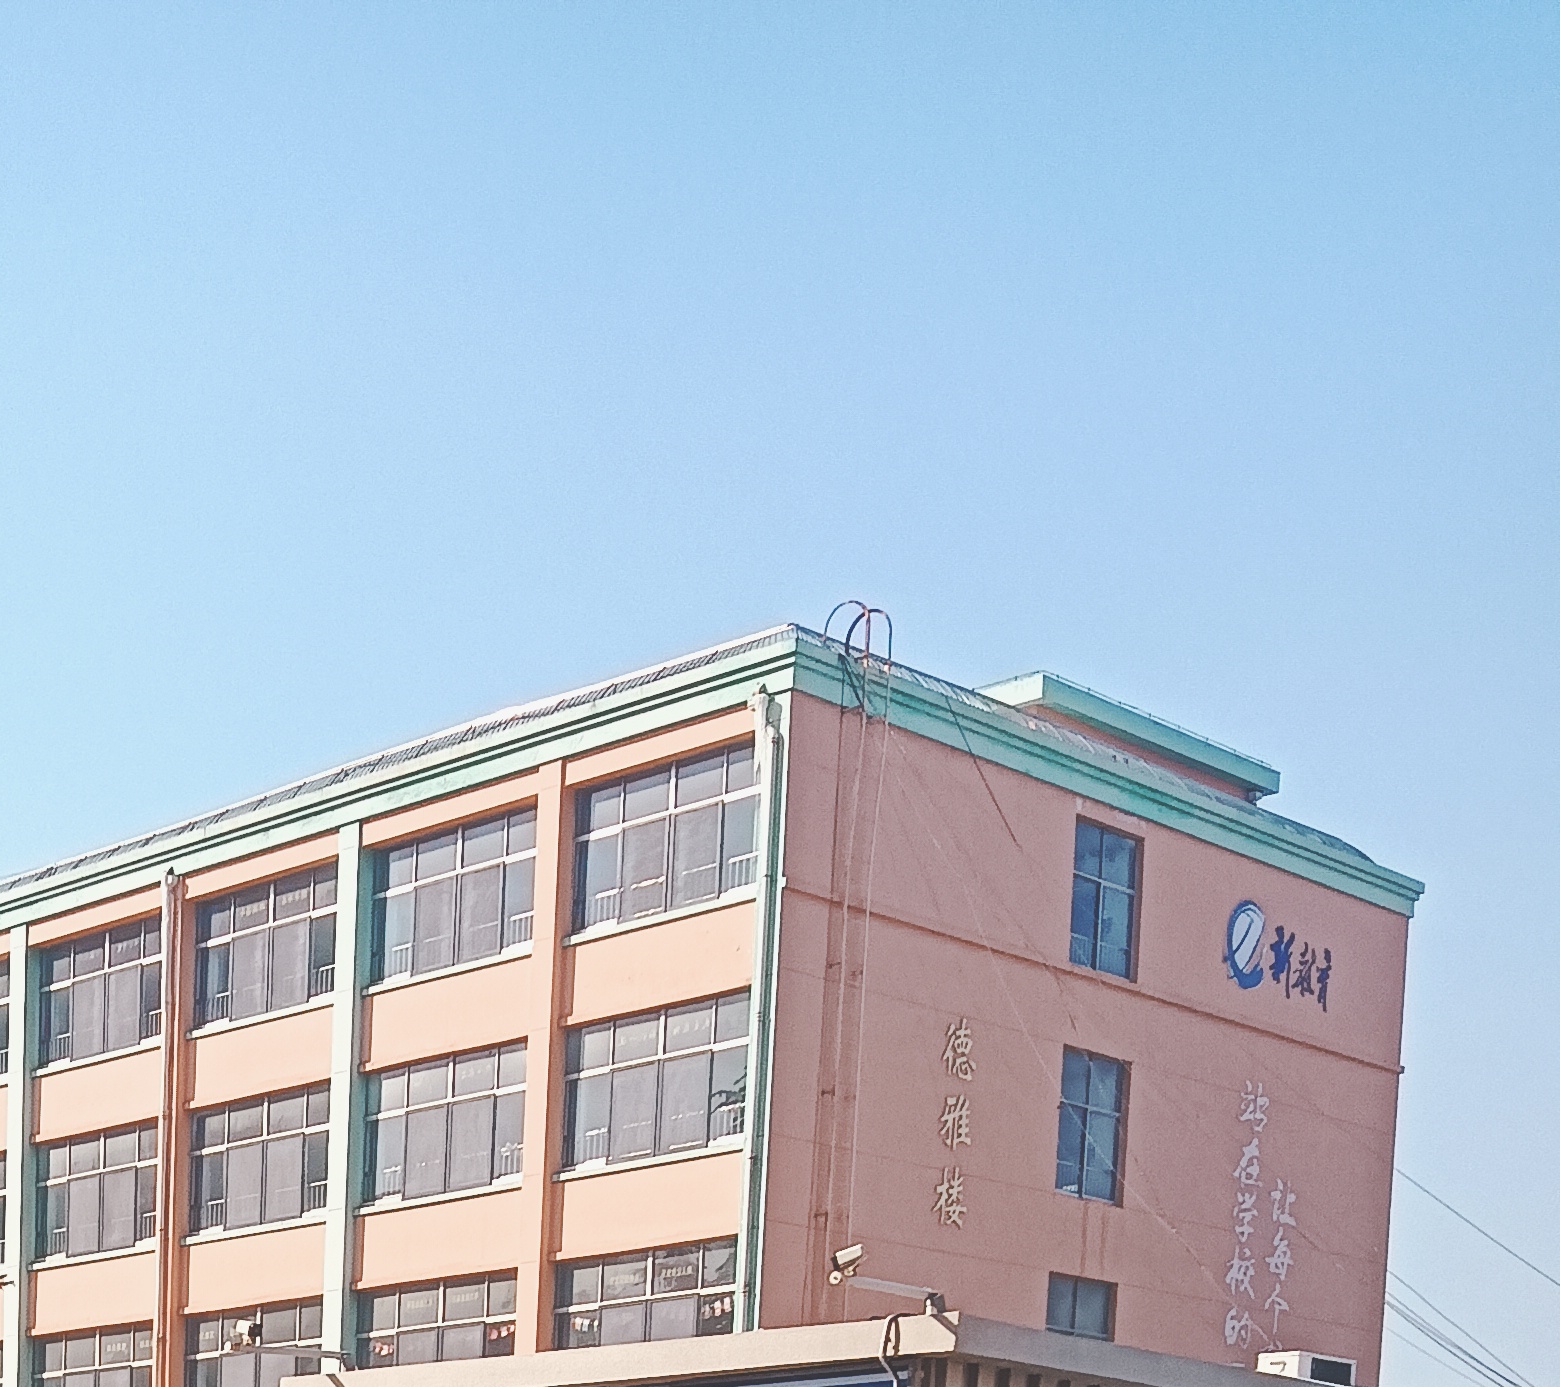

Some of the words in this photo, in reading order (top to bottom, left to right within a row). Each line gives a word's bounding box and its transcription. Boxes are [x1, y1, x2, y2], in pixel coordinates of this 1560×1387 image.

[932, 1018, 976, 1229] 德雅楼
[1262, 1178, 1297, 1351] 让每个
